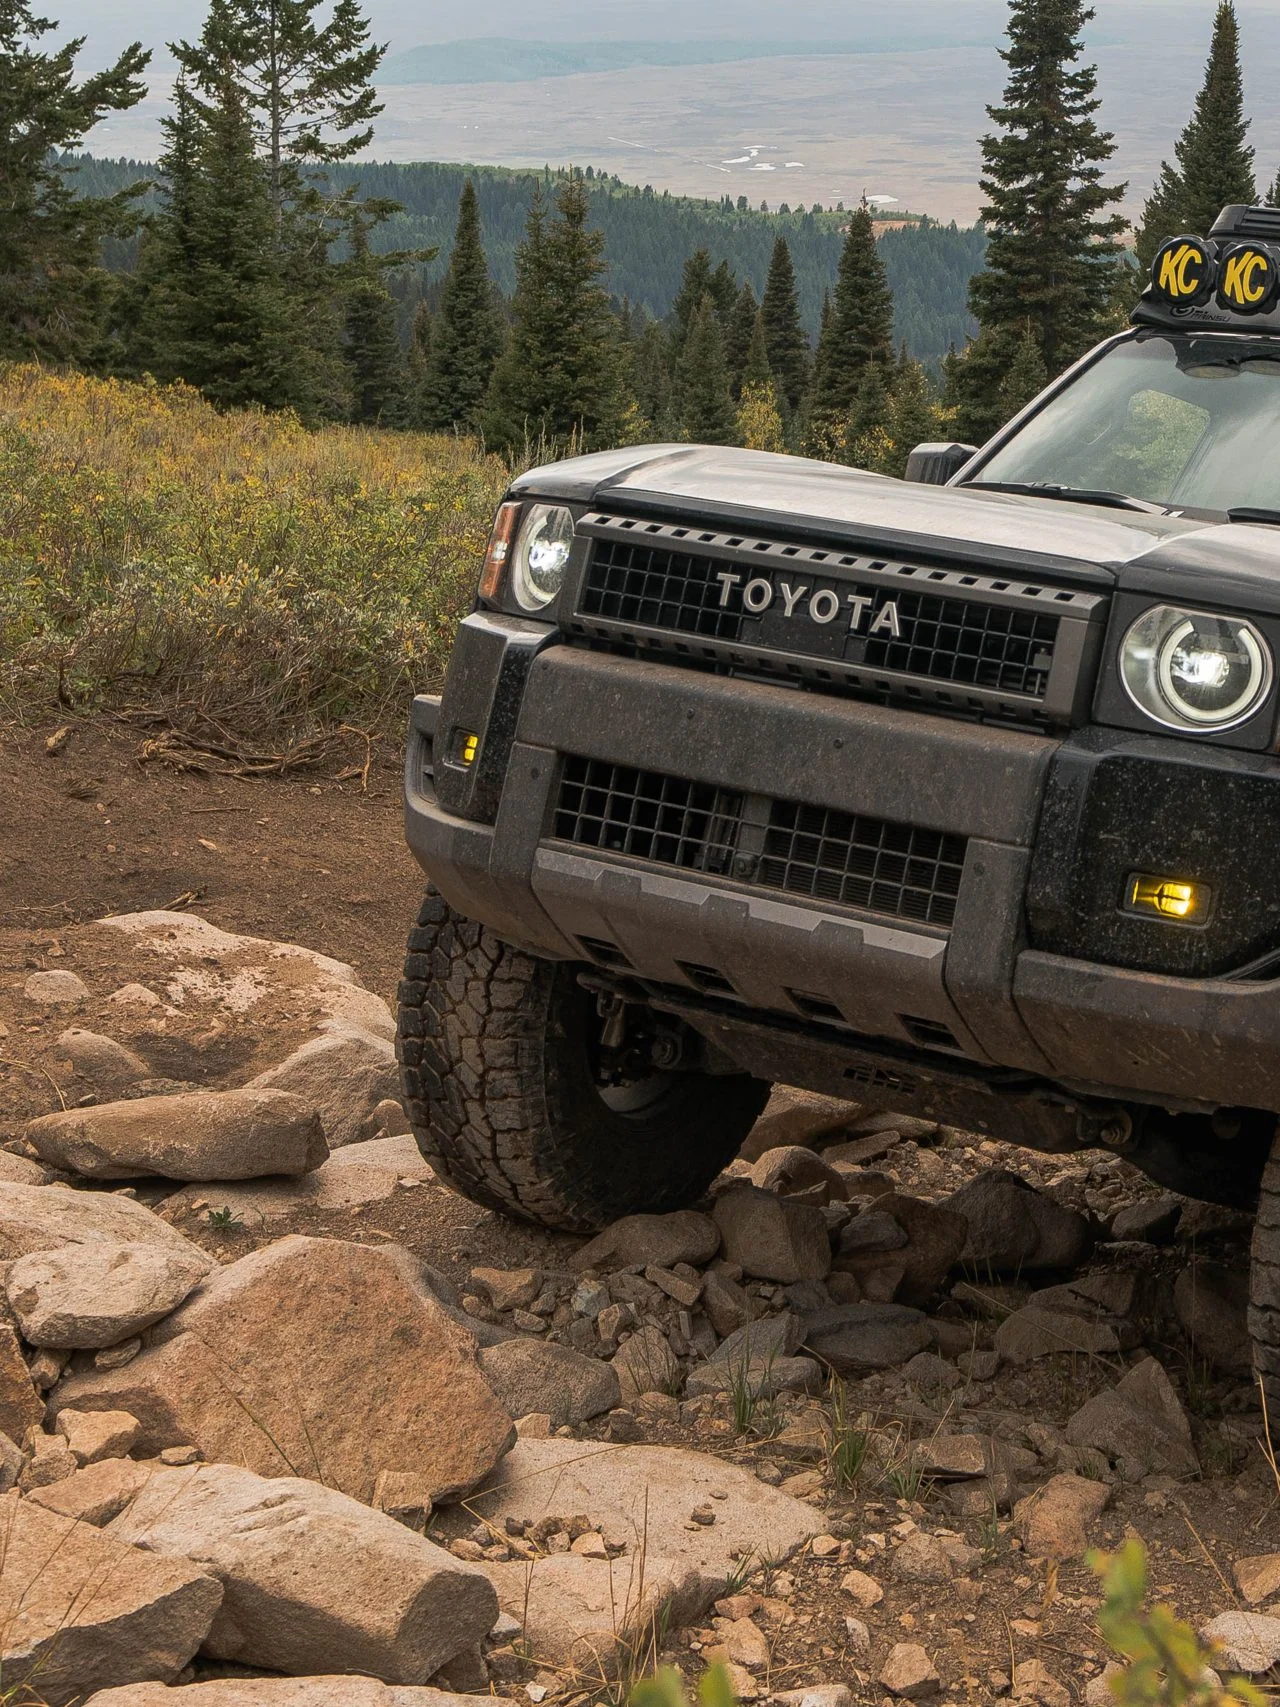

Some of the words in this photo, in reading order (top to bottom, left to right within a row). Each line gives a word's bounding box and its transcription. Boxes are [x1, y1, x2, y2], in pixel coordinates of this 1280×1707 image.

[1159, 244, 1202, 296] KC
[1224, 251, 1268, 304] KC
[716, 572, 900, 637] TOYOTA
